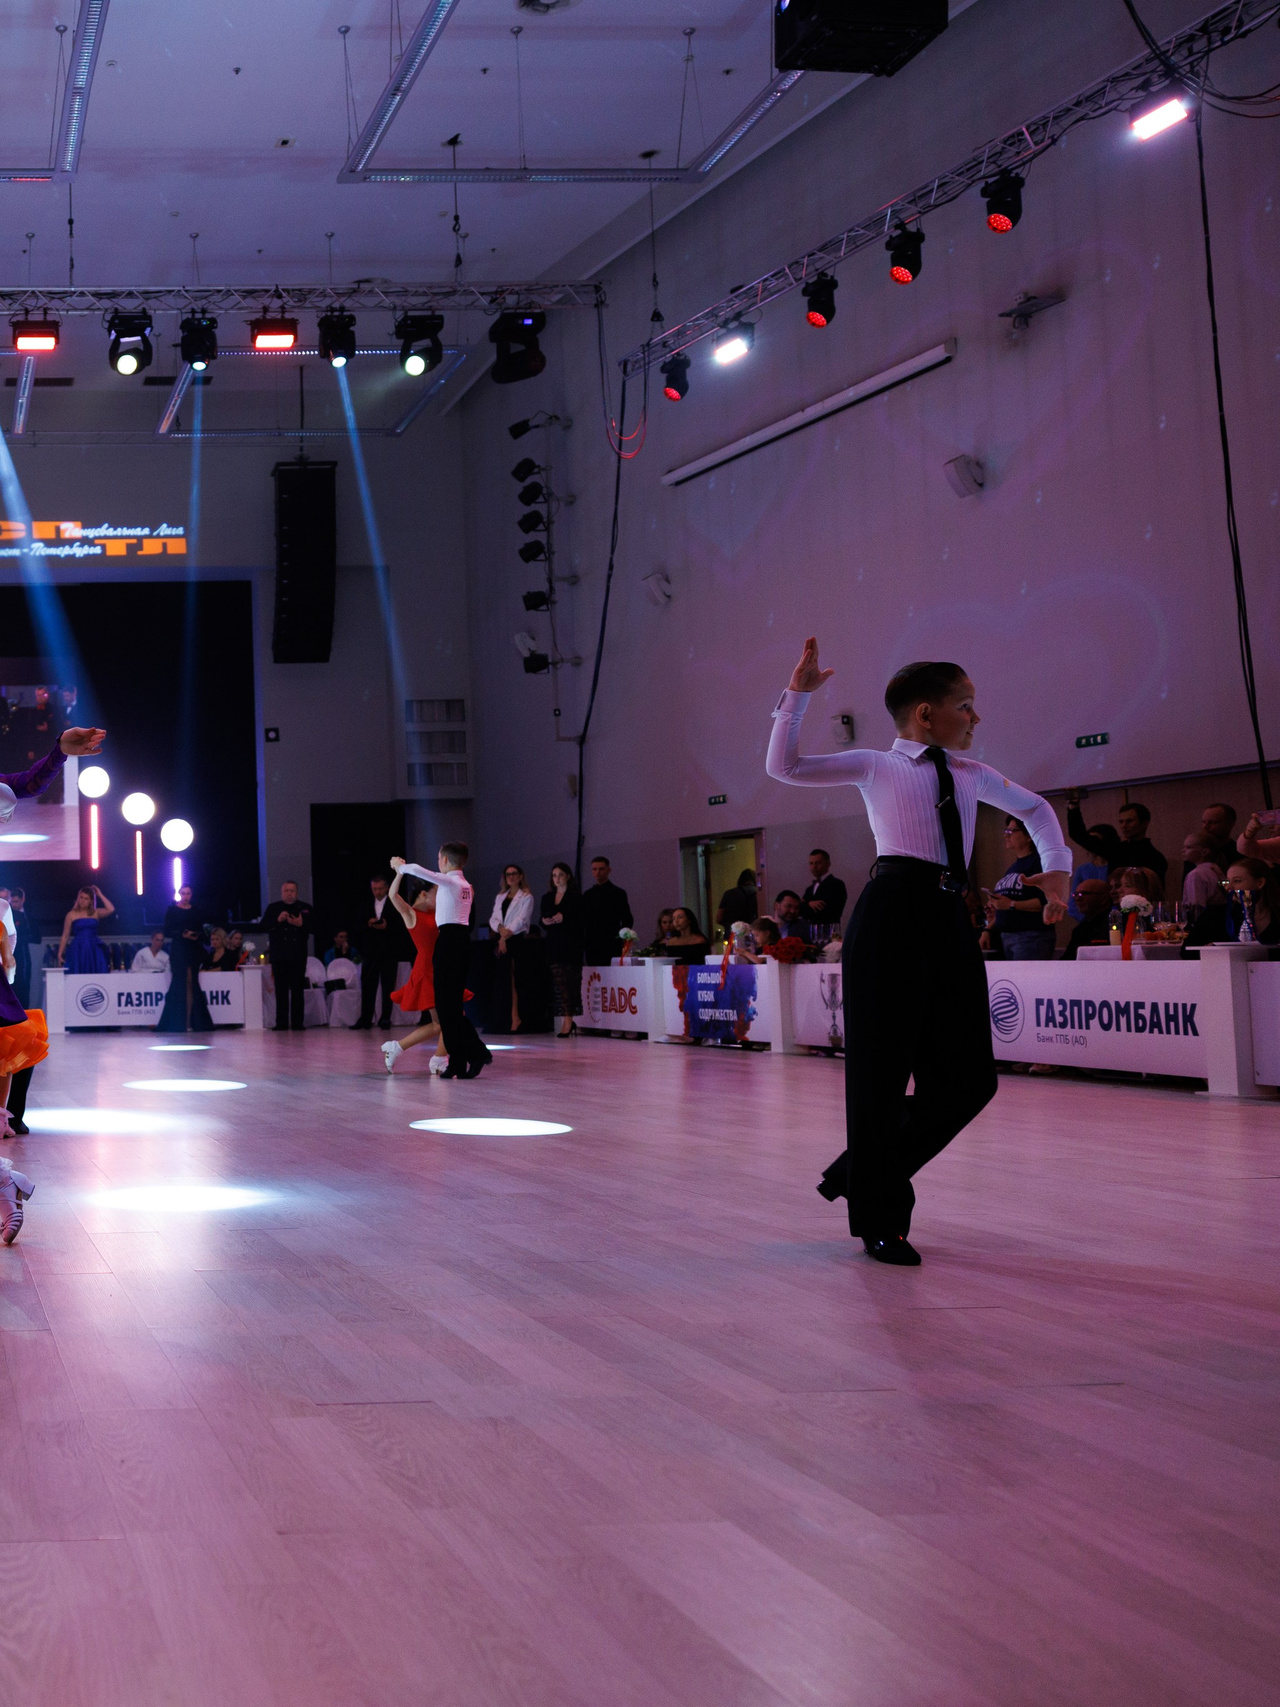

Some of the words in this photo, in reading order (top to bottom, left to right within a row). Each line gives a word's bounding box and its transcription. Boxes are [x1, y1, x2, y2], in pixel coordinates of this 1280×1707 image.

[60, 522, 150, 538] Танцевальная
[153, 522, 185, 537] Лига
[94, 537, 188, 557] ТЛ
[601, 987, 638, 1015] EADC
[697, 990, 715, 1002] КУБОК
[699, 1008, 738, 1021] СОДРУЖЕСТВА
[1035, 998, 1200, 1037] ГАЗПРОМБАНК
[1036, 1032, 1055, 1044] Банк
[1056, 1034, 1070, 1045] ГПБ
[1071, 1034, 1088, 1048] (АО)
